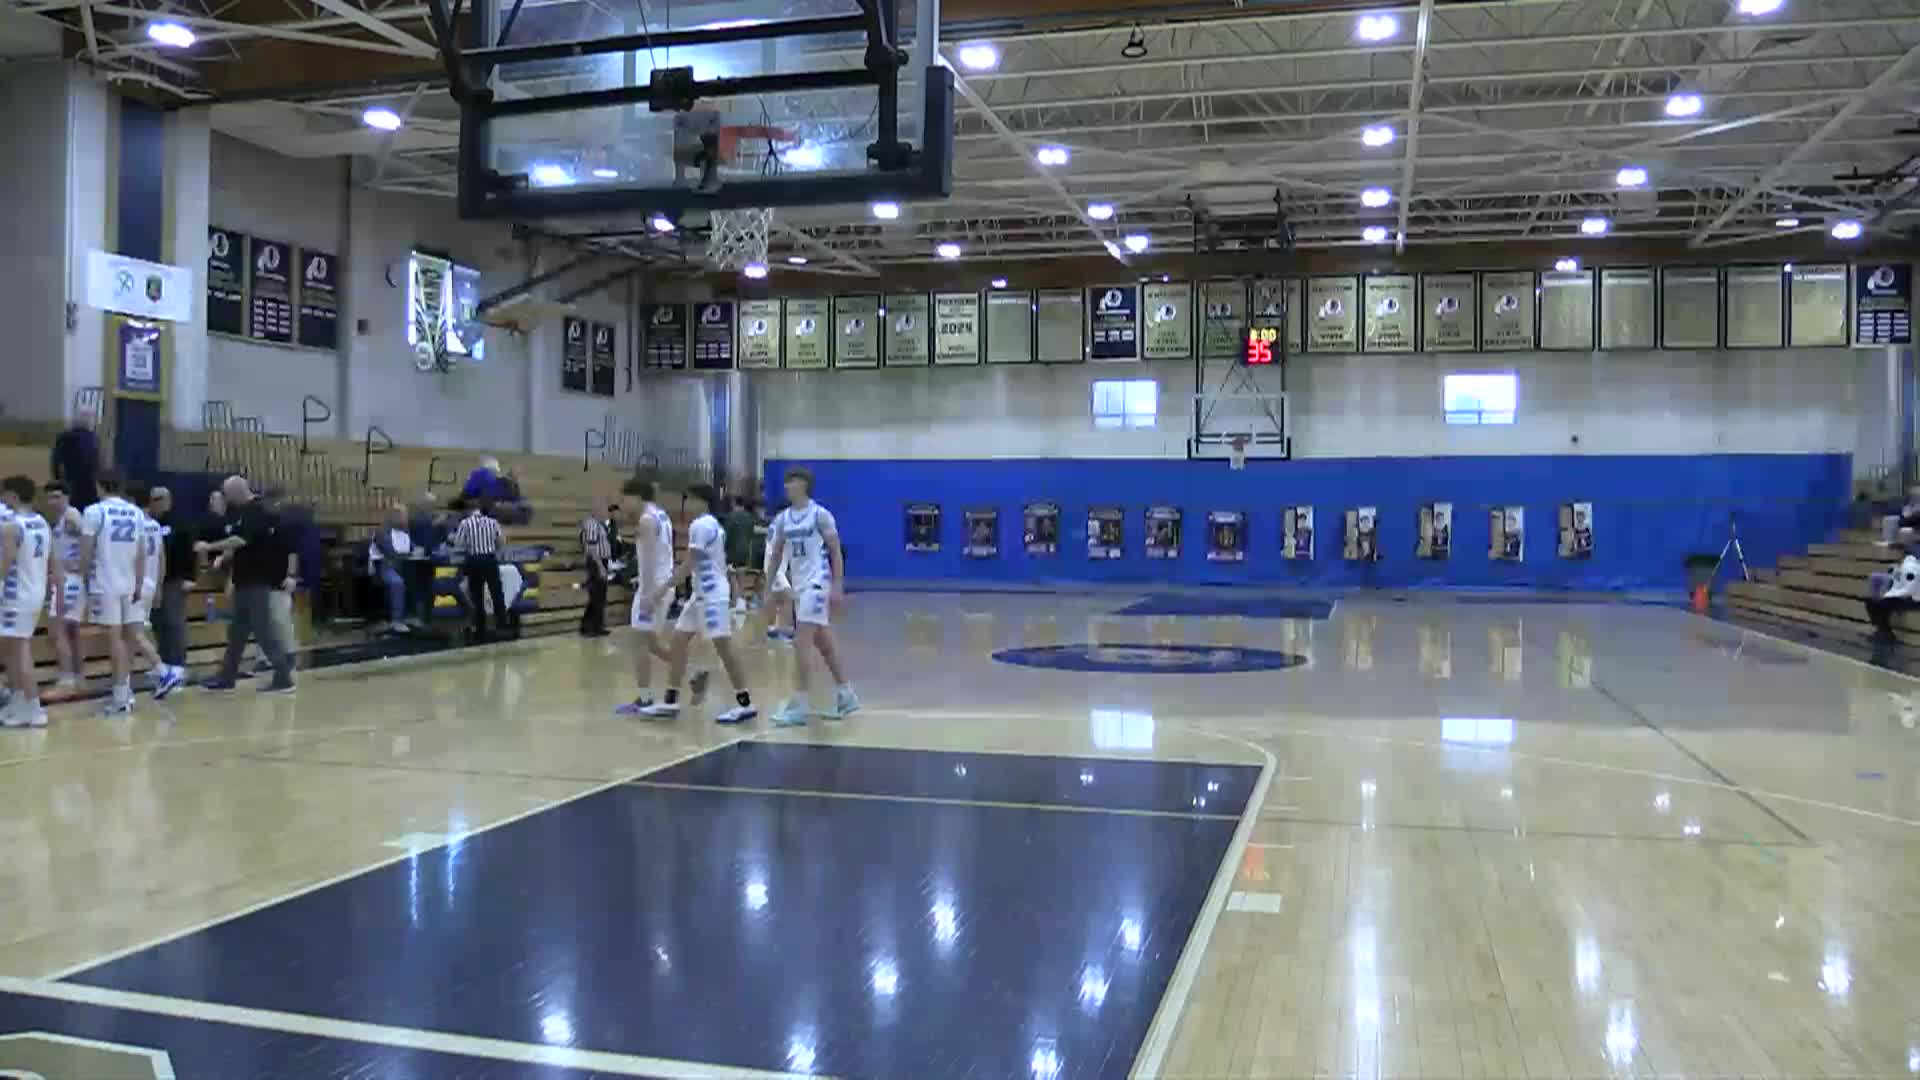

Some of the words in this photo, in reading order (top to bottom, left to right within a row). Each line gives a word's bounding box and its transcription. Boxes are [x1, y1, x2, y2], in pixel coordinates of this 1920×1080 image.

[942, 322, 973, 335] 2024
[1247, 339, 1273, 363] 35
[111, 519, 136, 542] 22
